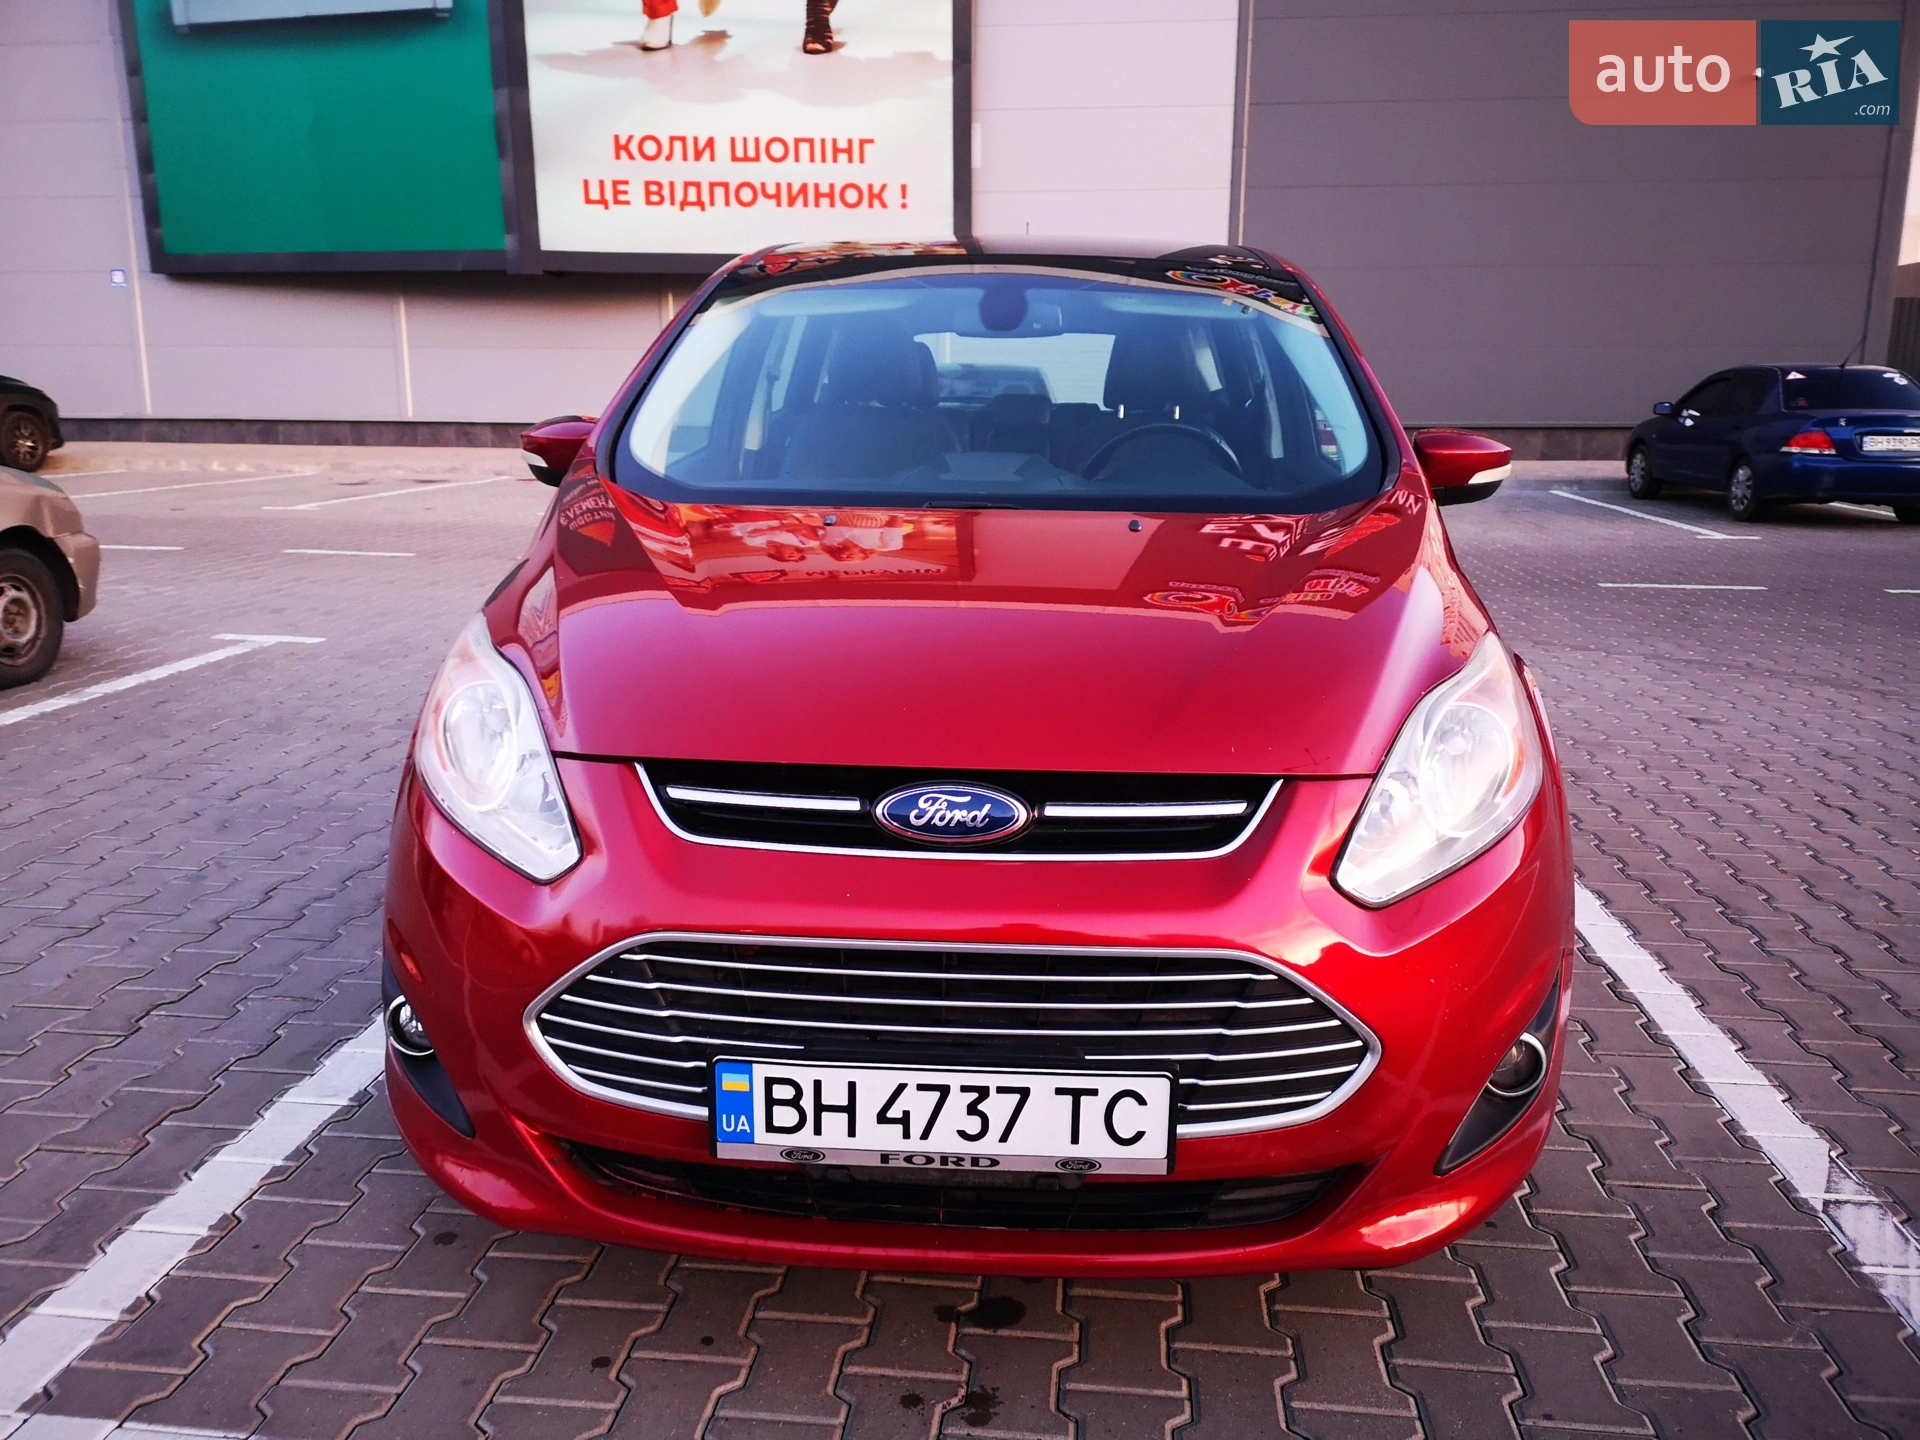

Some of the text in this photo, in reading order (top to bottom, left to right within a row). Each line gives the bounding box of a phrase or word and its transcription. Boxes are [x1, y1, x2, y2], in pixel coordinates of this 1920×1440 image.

[613, 134, 875, 164] КОЛИ ШОПІНГ
[583, 179, 631, 210] ЦЕ
[643, 180, 889, 212] ВІДПОЧИНОК
[909, 793, 992, 828] Ford
[722, 1113, 751, 1133] UA
[764, 1076, 1148, 1146] BH 4737 TC
[790, 1148, 1090, 1171] Ford FORD Ford
